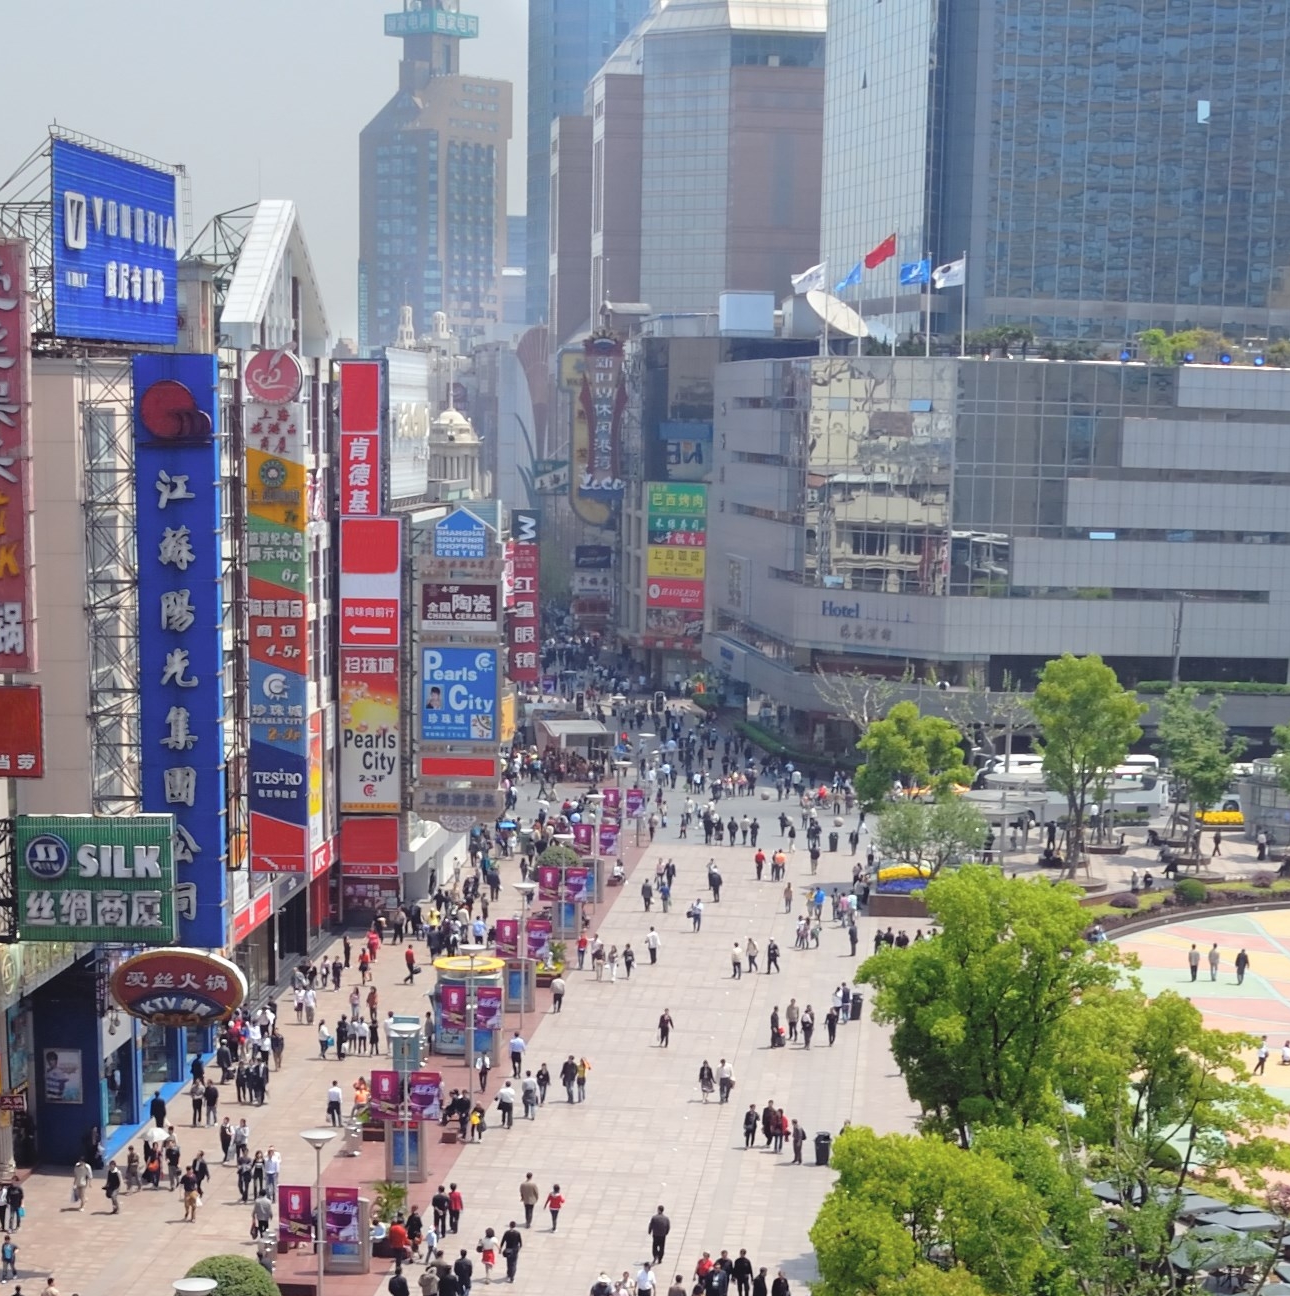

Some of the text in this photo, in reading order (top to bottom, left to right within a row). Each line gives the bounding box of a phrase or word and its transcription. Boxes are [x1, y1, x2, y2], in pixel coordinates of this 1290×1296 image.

[348, 437, 372, 513] 肯德基
[436, 529, 485, 537] SHANGHAI
[249, 546, 302, 562] 展示中心
[436, 549, 484, 557] CENTER
[281, 568, 300, 583] 6F
[344, 606, 395, 618] 美味向前行
[427, 612, 492, 621] CHINA CERAMIC
[821, 600, 860, 618] Hotel
[265, 644, 302, 658] 4-5F
[344, 656, 395, 674] 珍珠城
[423, 650, 478, 682] Pearls
[448, 683, 494, 714] City
[252, 704, 303, 717] 珍珠城
[249, 717, 304, 725] PEARLS CITY
[428, 713, 466, 725] 珍珠城
[267, 727, 302, 742] 2-3F
[343, 728, 396, 749] Pearls
[362, 750, 396, 776] City
[358, 774, 386, 782] 2-3F
[76, 843, 162, 879] SILK
[25, 889, 163, 927] 丝绸商厦
[124, 971, 229, 992] 爱丝火锅
[140, 996, 177, 1013] KTV
